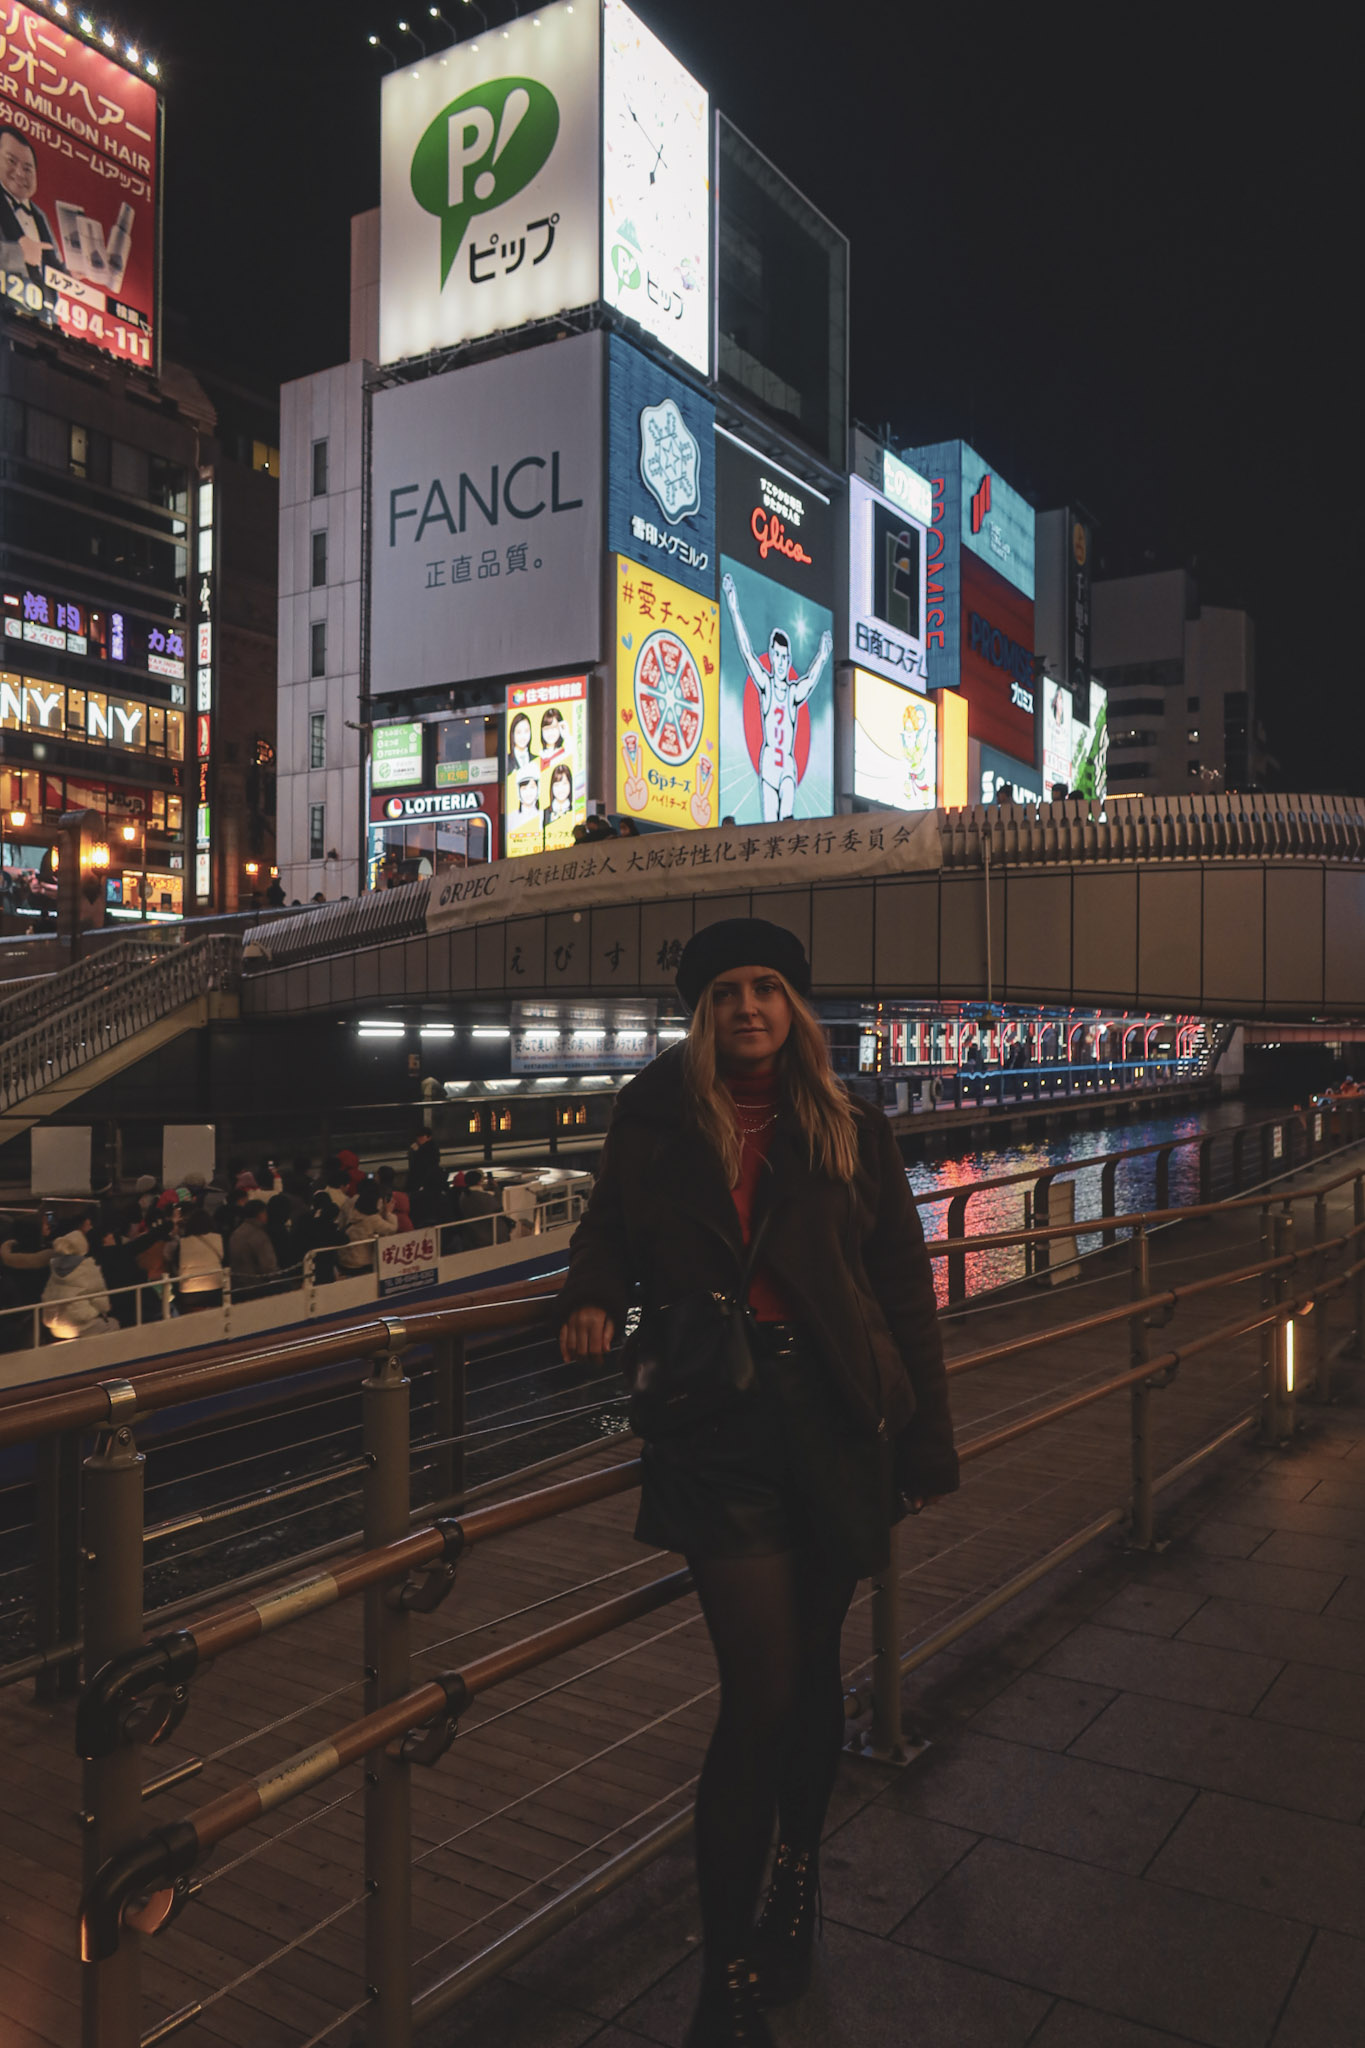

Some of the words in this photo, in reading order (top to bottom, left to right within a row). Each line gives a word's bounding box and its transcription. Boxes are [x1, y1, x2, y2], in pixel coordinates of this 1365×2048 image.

[25, 87, 100, 146] MILLION
[103, 134, 150, 174] HAIR
[469, 212, 561, 284] ピップ
[389, 450, 584, 548] FANCL
[750, 507, 813, 565] Glico
[424, 542, 543, 589] 正直品質。
[87, 700, 143, 745] NY
[404, 792, 478, 815] LOTTERIA
